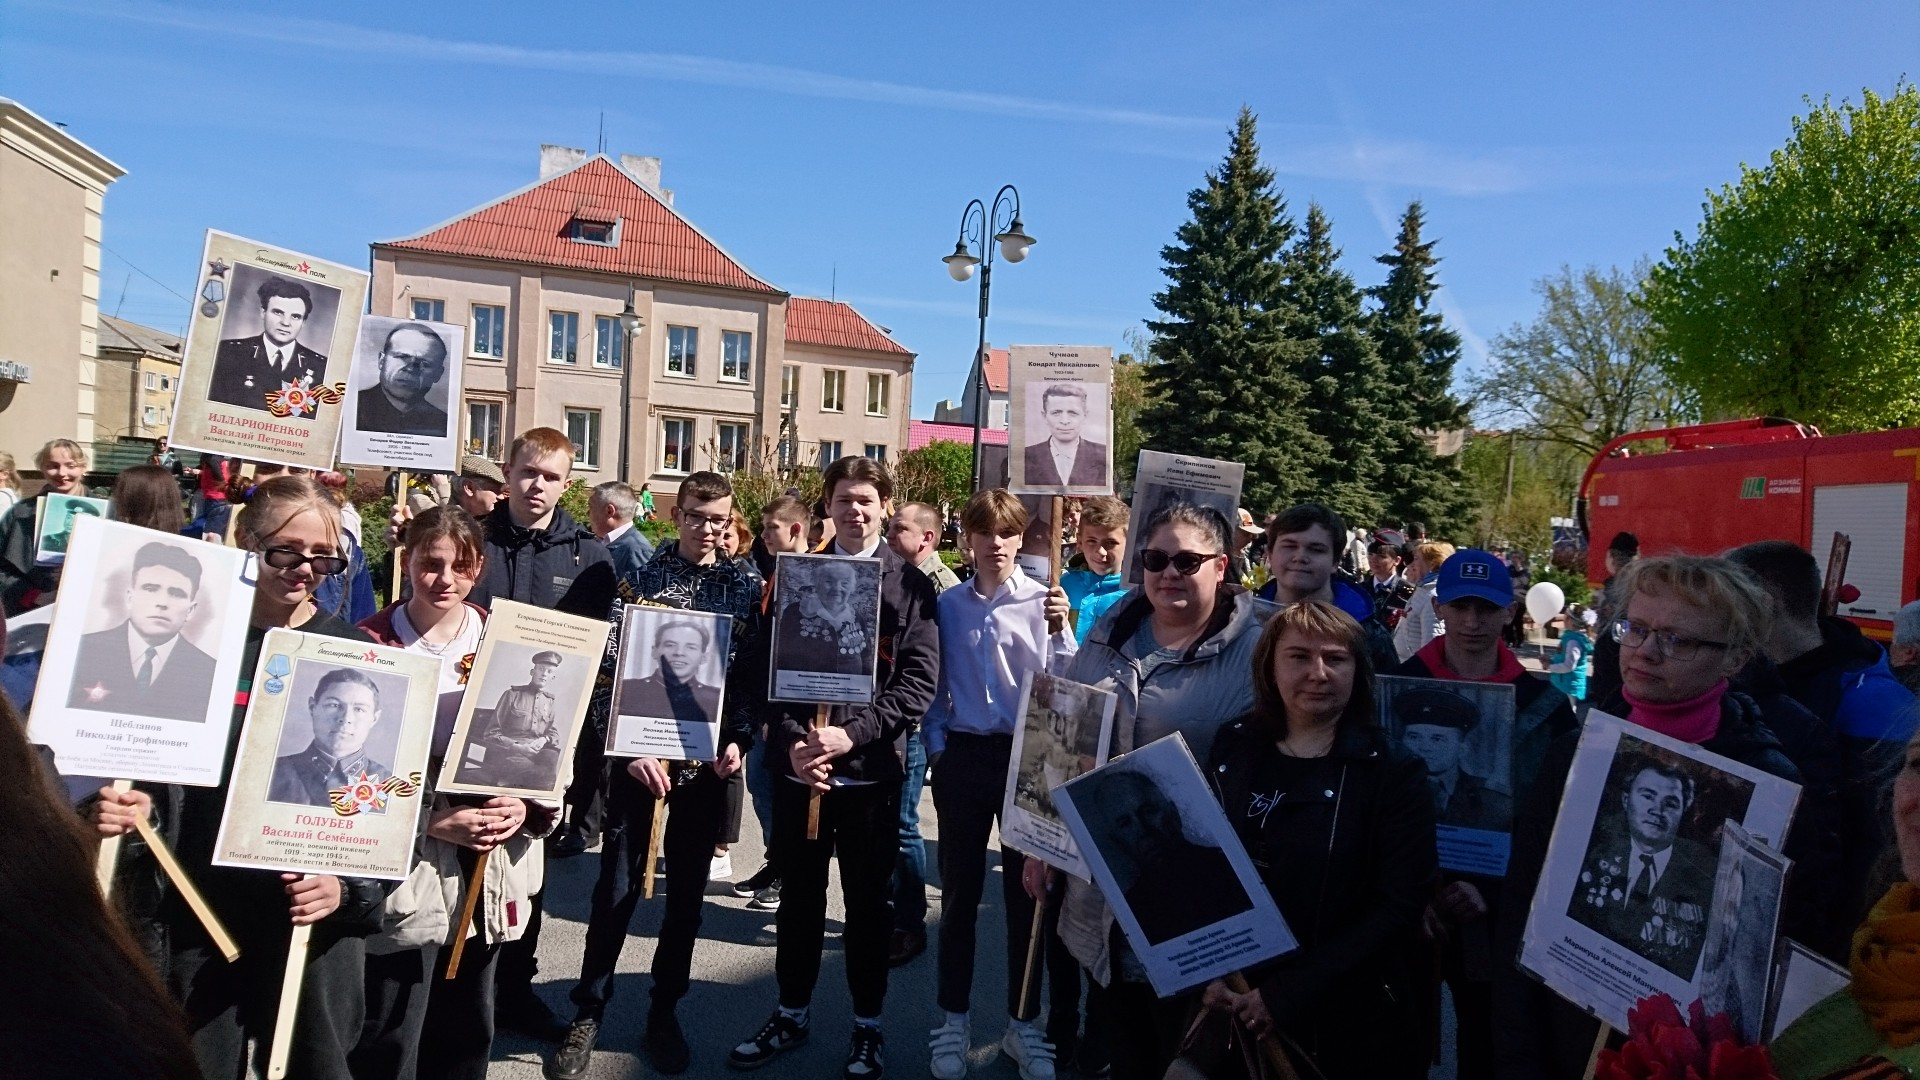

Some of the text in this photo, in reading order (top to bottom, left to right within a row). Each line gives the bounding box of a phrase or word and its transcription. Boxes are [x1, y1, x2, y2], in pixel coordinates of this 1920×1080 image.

[208, 413, 310, 438] ИЛЛАРИОНЕНКОВ
[210, 425, 304, 448] Василий Петрович
[1167, 467, 1221, 480] Иван Ефимович
[376, 658, 396, 667] ПОЛК
[110, 718, 162, 732] Щебланов
[75, 729, 188, 748] Николай Трофимович
[295, 814, 354, 830] ГОЛУБЕВ
[261, 825, 379, 846] Василий Семёнович
[265, 840, 371, 854] лейтенант, военный инженер
[284, 848, 300, 856] 1919
[326, 852, 343, 860] 1945
[228, 851, 252, 860] Погиб
[261, 855, 288, 864] пропал
[289, 856, 302, 864] без
[331, 860, 368, 870] Восточной
[369, 864, 399, 873] Пруссии
[1563, 935, 1600, 961] Марикуца
[1601, 957, 1632, 979] Алексей
